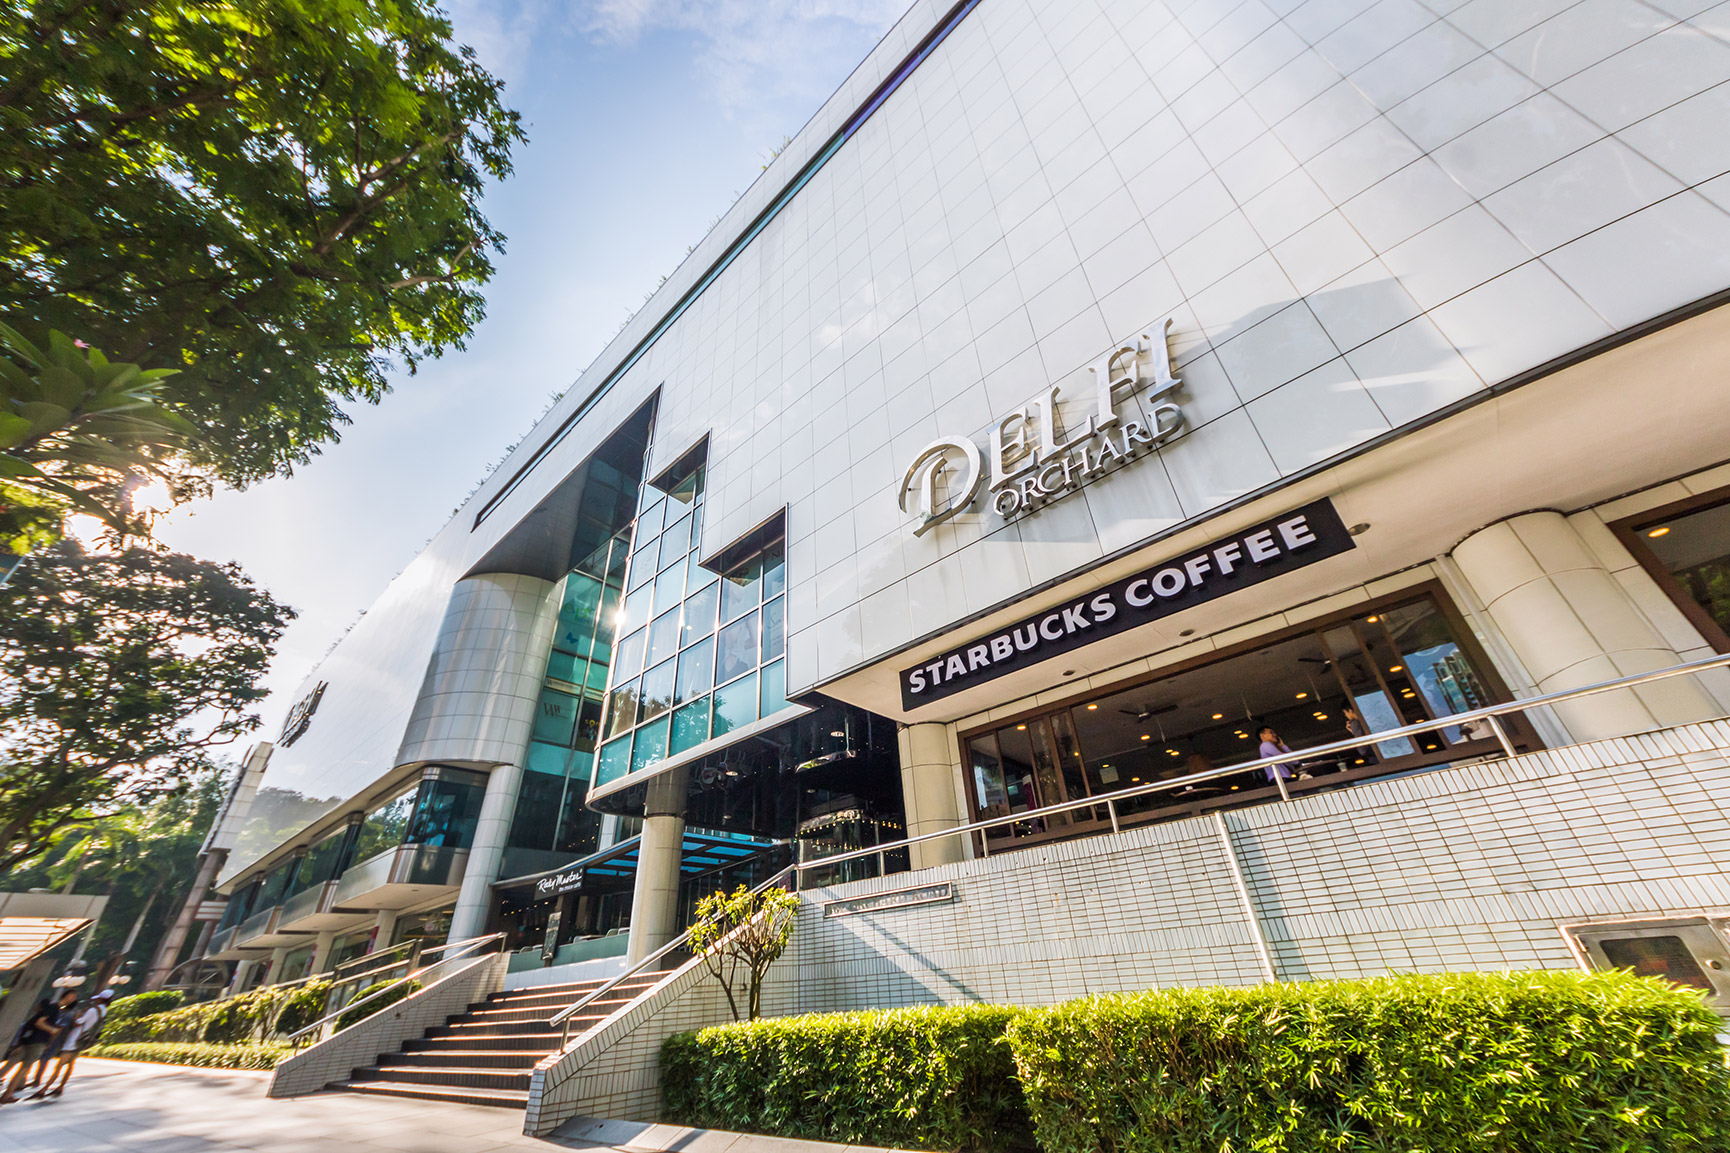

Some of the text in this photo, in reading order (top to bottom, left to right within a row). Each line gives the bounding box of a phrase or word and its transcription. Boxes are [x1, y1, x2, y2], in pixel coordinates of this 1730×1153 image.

[898, 317, 1184, 538] DELFI
[993, 402, 1185, 517] ORCHARD
[909, 514, 1316, 694] STARBUCKS COFFEE
